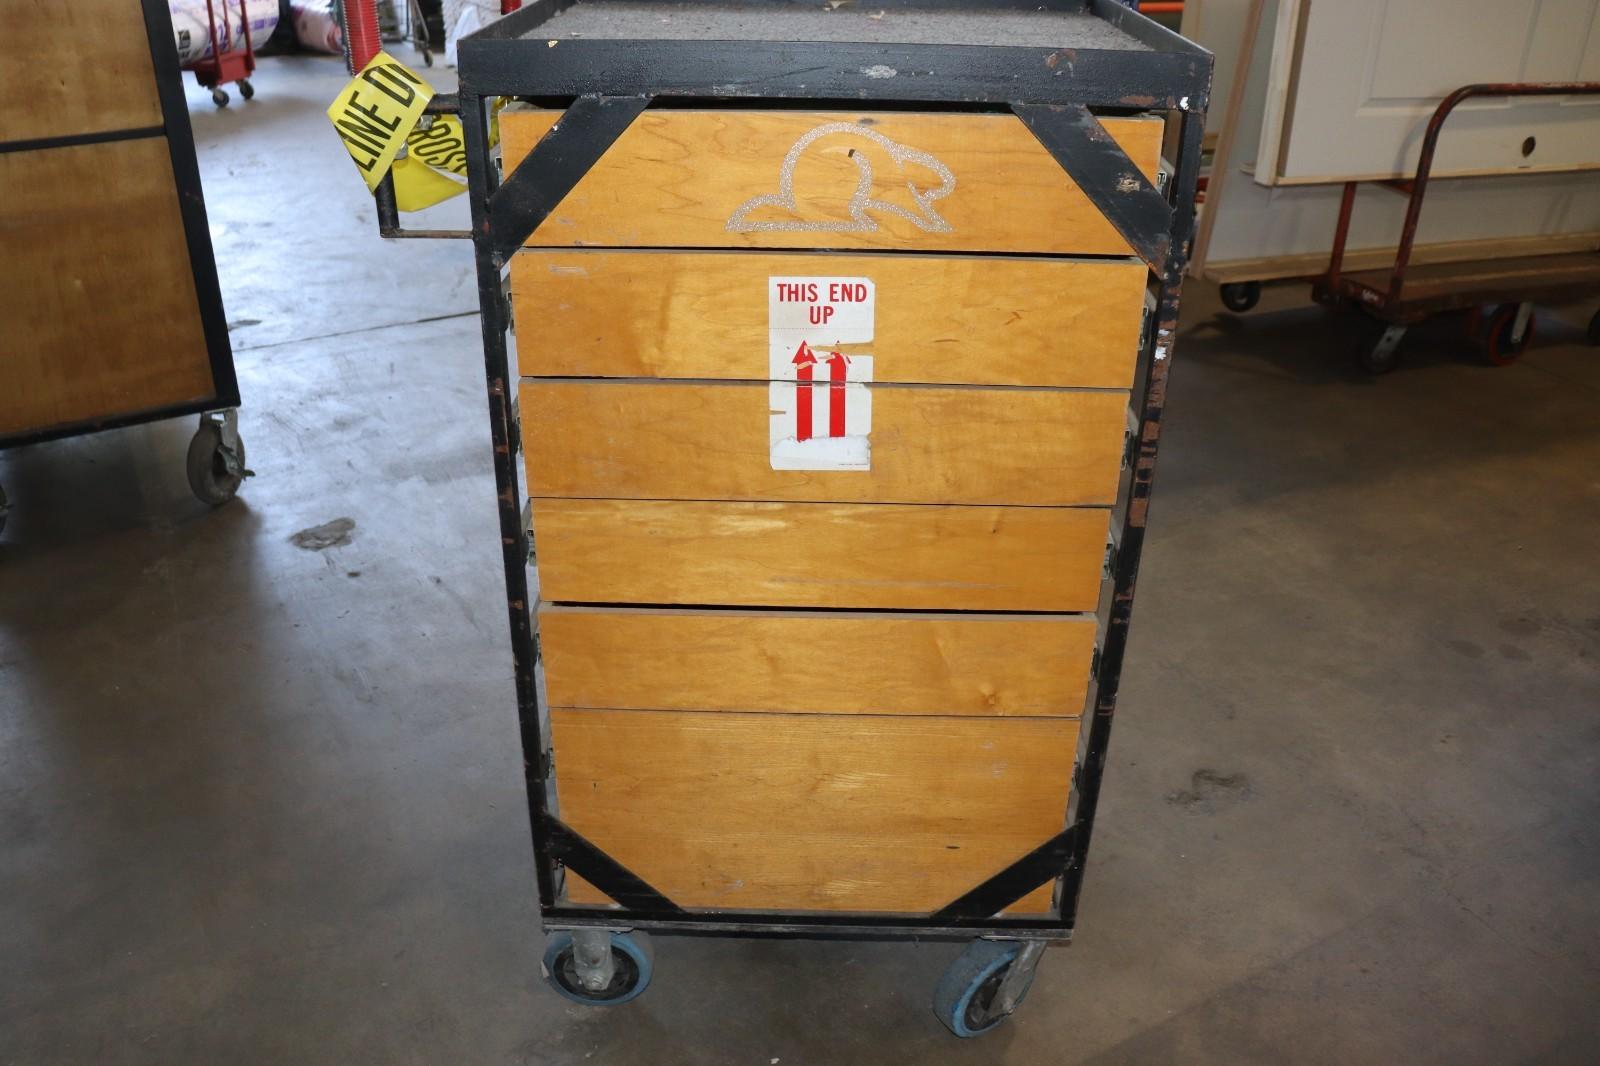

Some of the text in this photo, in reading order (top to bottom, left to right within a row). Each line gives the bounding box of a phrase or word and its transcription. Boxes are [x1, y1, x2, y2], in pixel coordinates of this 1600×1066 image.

[334, 90, 402, 172] LINE
[777, 283, 867, 303] THIS END
[809, 306, 834, 325] UP
